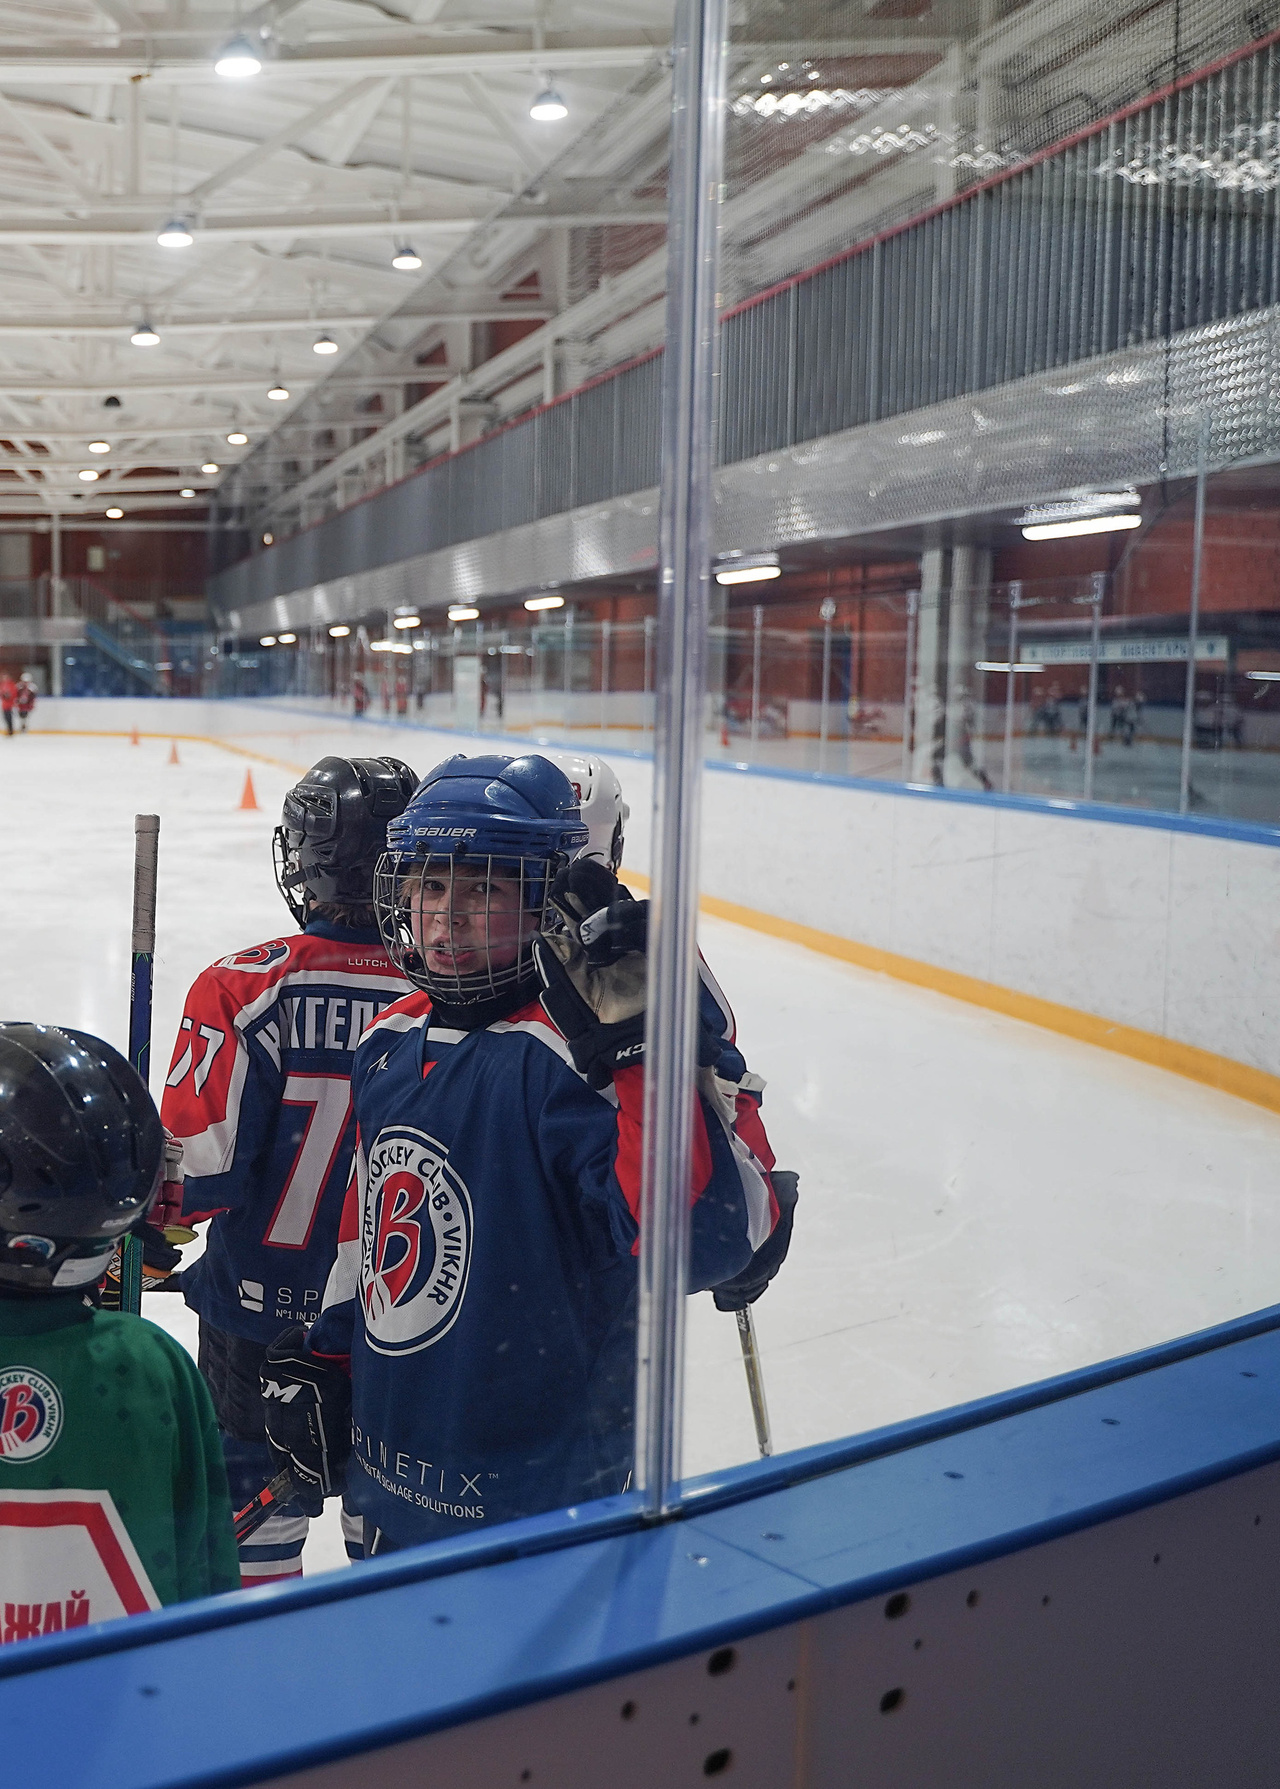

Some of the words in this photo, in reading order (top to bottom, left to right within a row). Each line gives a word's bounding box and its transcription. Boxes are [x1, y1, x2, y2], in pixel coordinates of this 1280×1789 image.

[347, 957, 388, 968] LUTCH
[427, 1225, 462, 1306] VIKHR
[296, 1311, 307, 1320] IN
[28, 1377, 52, 1399] CLUB
[42, 1402, 56, 1439] VIKHR
[415, 1492, 485, 1519] SOLUTIONS
